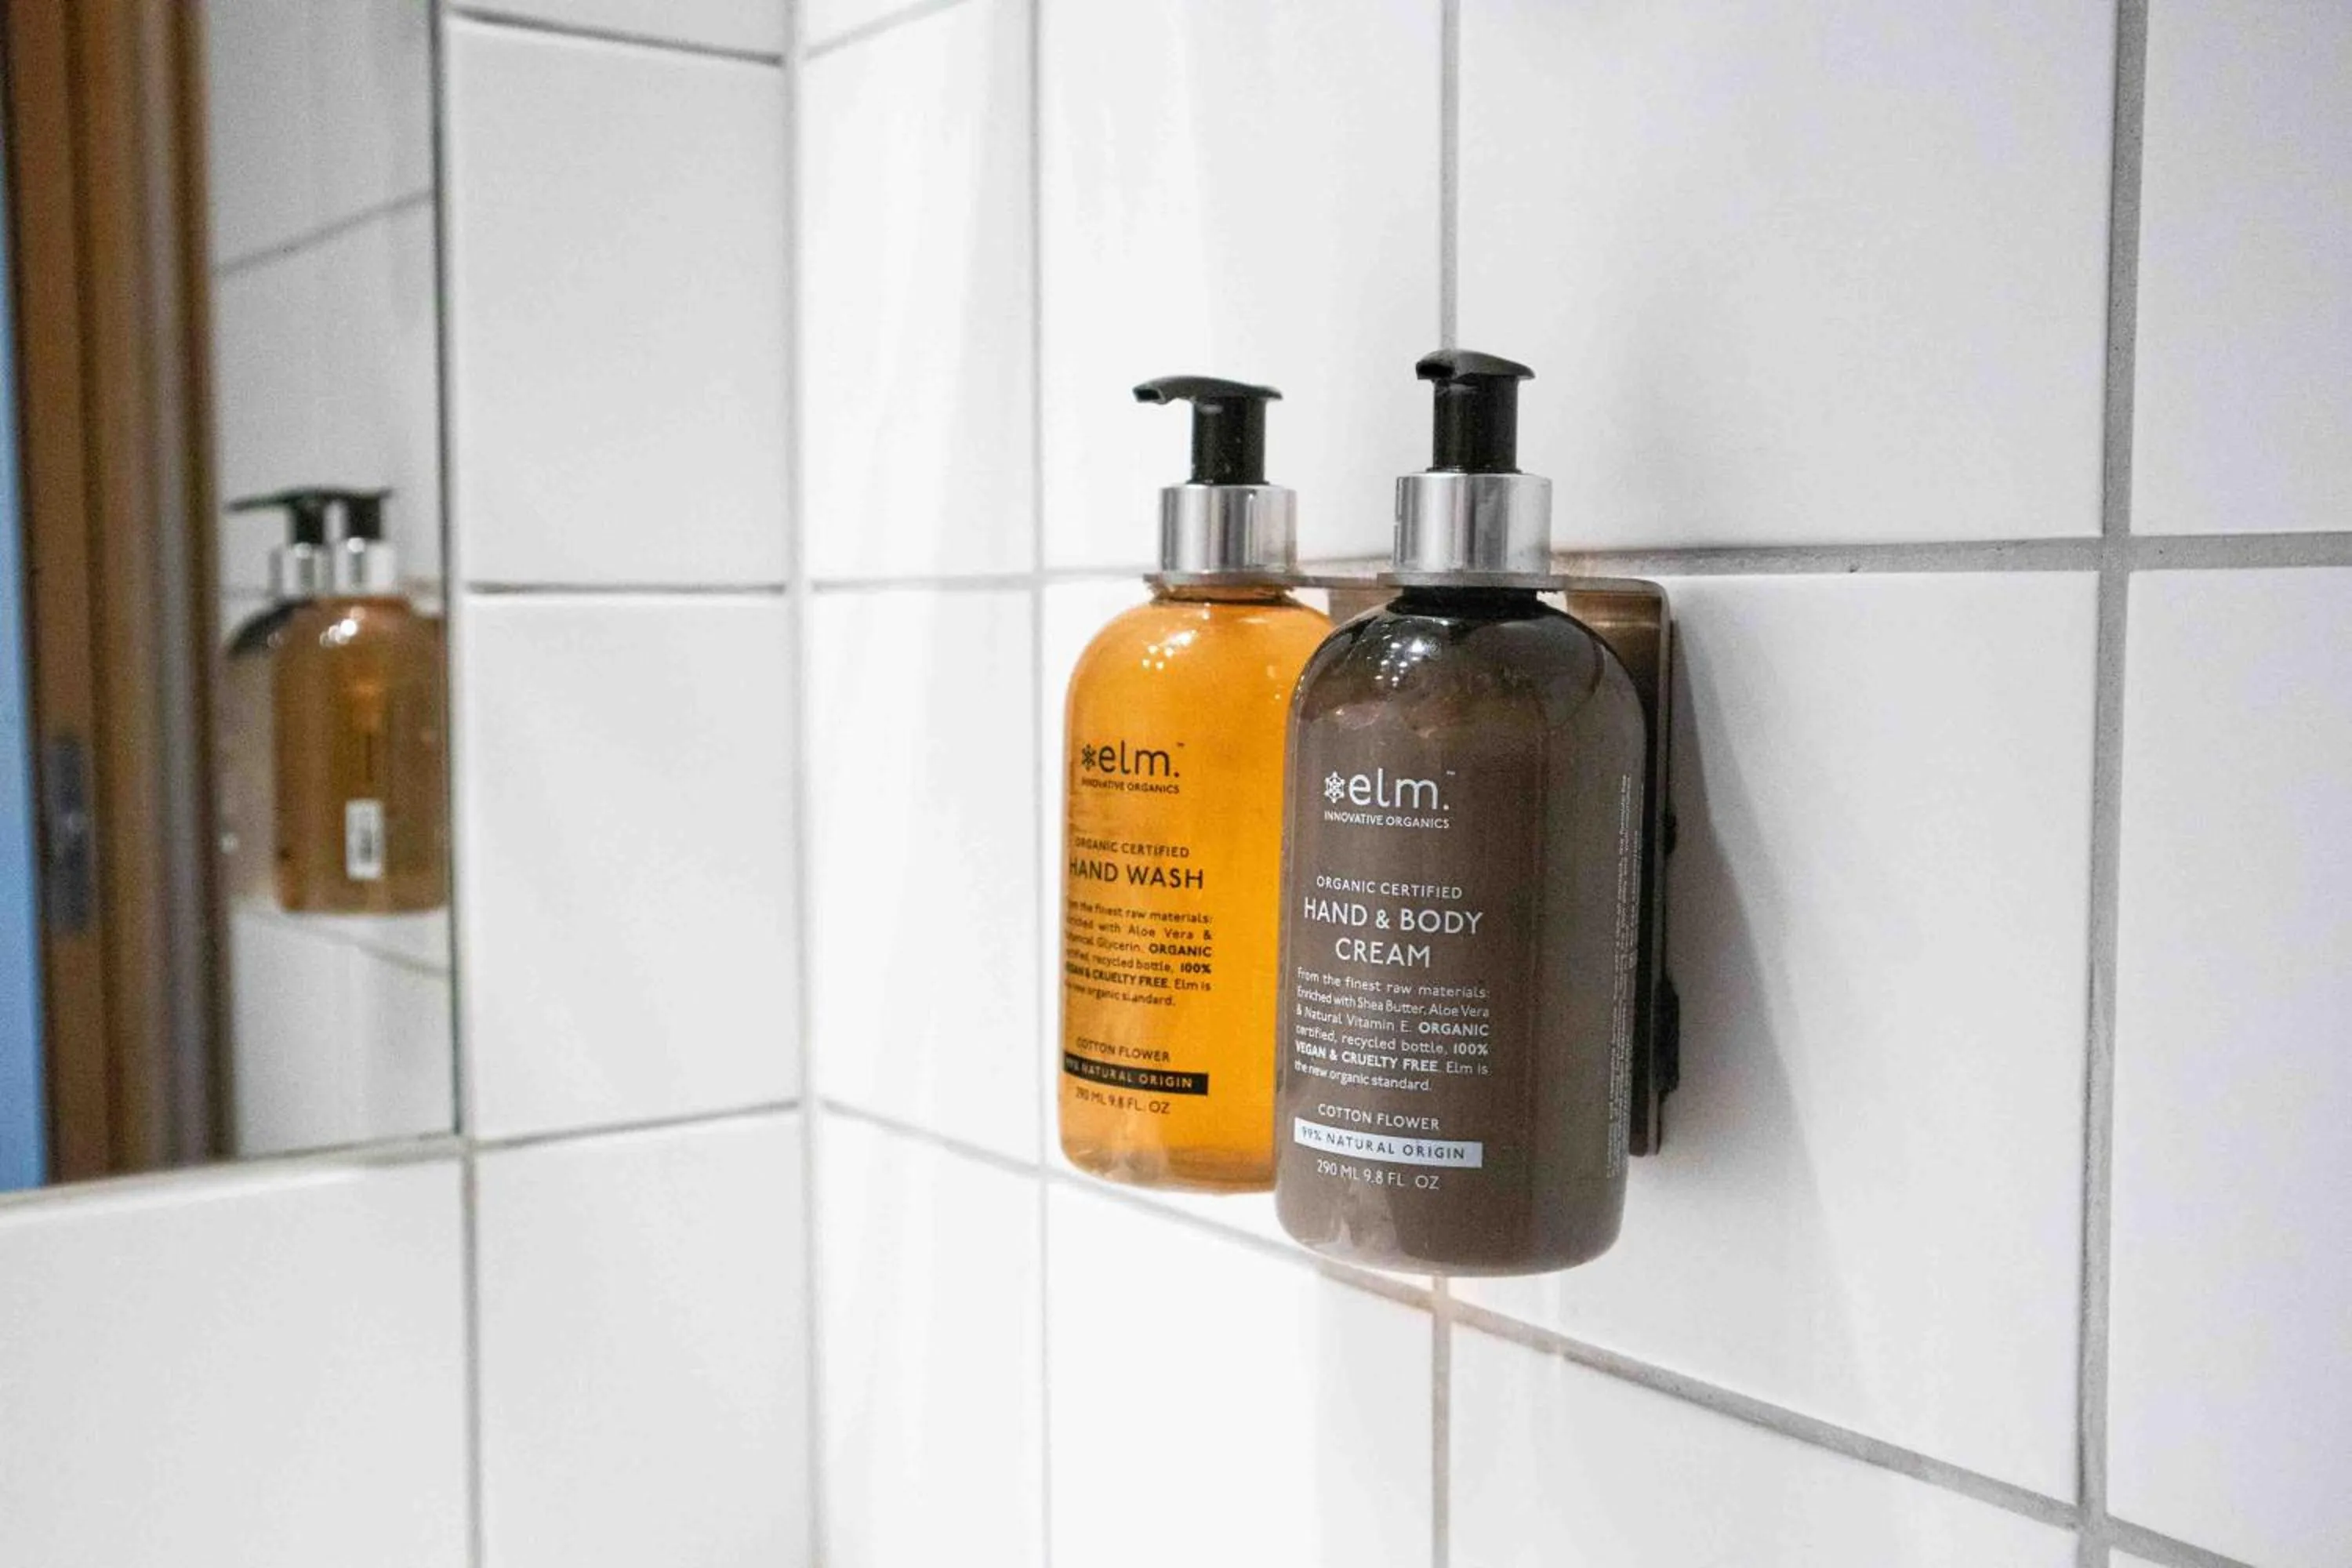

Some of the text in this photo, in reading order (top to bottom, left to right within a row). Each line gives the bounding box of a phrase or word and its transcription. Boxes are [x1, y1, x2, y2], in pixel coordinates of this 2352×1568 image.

[1098, 740, 1180, 778] elm.
[1081, 777, 1179, 794] INNOVATIVE ORGANICS
[1348, 768, 1450, 811] elm.
[1324, 811, 1450, 829] INNOVATIVE ORGANICS
[1075, 837, 1190, 858] ORGANIC CERTIFIED
[1069, 857, 1203, 889] HAND WASH
[1316, 876, 1462, 900] ORGANIC CERTIFIED
[1125, 909, 1146, 919] raw
[1304, 897, 1483, 934] HAND & BODY
[1128, 924, 1156, 938] Aloe
[1164, 927, 1194, 940] Vera
[1203, 929, 1212, 940] &
[1149, 943, 1212, 957] ORGANIC
[1335, 938, 1431, 967] CREAM
[1093, 968, 1136, 985] CRUELTY
[1174, 978, 1199, 990] Elm
[1200, 981, 1211, 991] is
[1180, 962, 1212, 975] 100%
[1298, 966, 1319, 982] From
[1323, 973, 1341, 987] the
[1345, 976, 1382, 992] finest
[1387, 983, 1412, 994] raw
[1297, 985, 1332, 1004] Enriched
[1334, 993, 1356, 1008] with
[1357, 996, 1384, 1011] Shea
[1428, 1003, 1458, 1016] Aloe
[1461, 1004, 1490, 1018] Vera
[1304, 1006, 1343, 1025] Natural
[1346, 1012, 1395, 1031] Vitamin
[1418, 1022, 1490, 1036] ORGANIC
[1076, 1036, 1171, 1062] COTTON FLOWER
[1294, 1039, 1327, 1058] VEGAN
[1329, 1048, 1338, 1061] &
[1341, 1051, 1398, 1069] CRUELTY
[1446, 1060, 1473, 1075] Elm
[1341, 1035, 1396, 1050] recycled
[1454, 1043, 1489, 1056] 100%
[1081, 1061, 1133, 1083] NATURAL
[1138, 1073, 1192, 1089] ORIGIN
[1294, 1059, 1308, 1073] the
[1308, 1065, 1328, 1077] new
[1329, 1069, 1370, 1086] organic
[1149, 1100, 1171, 1114] OZ
[1318, 1103, 1439, 1131] COTTON FLOWER
[1325, 1133, 1395, 1155] NATURAL
[1403, 1144, 1465, 1160] ORIGIN
[1317, 1159, 1338, 1176] 290
[1340, 1164, 1360, 1180] ML
[1363, 1168, 1384, 1185] 9.8
[1415, 1174, 1439, 1190] OZ
